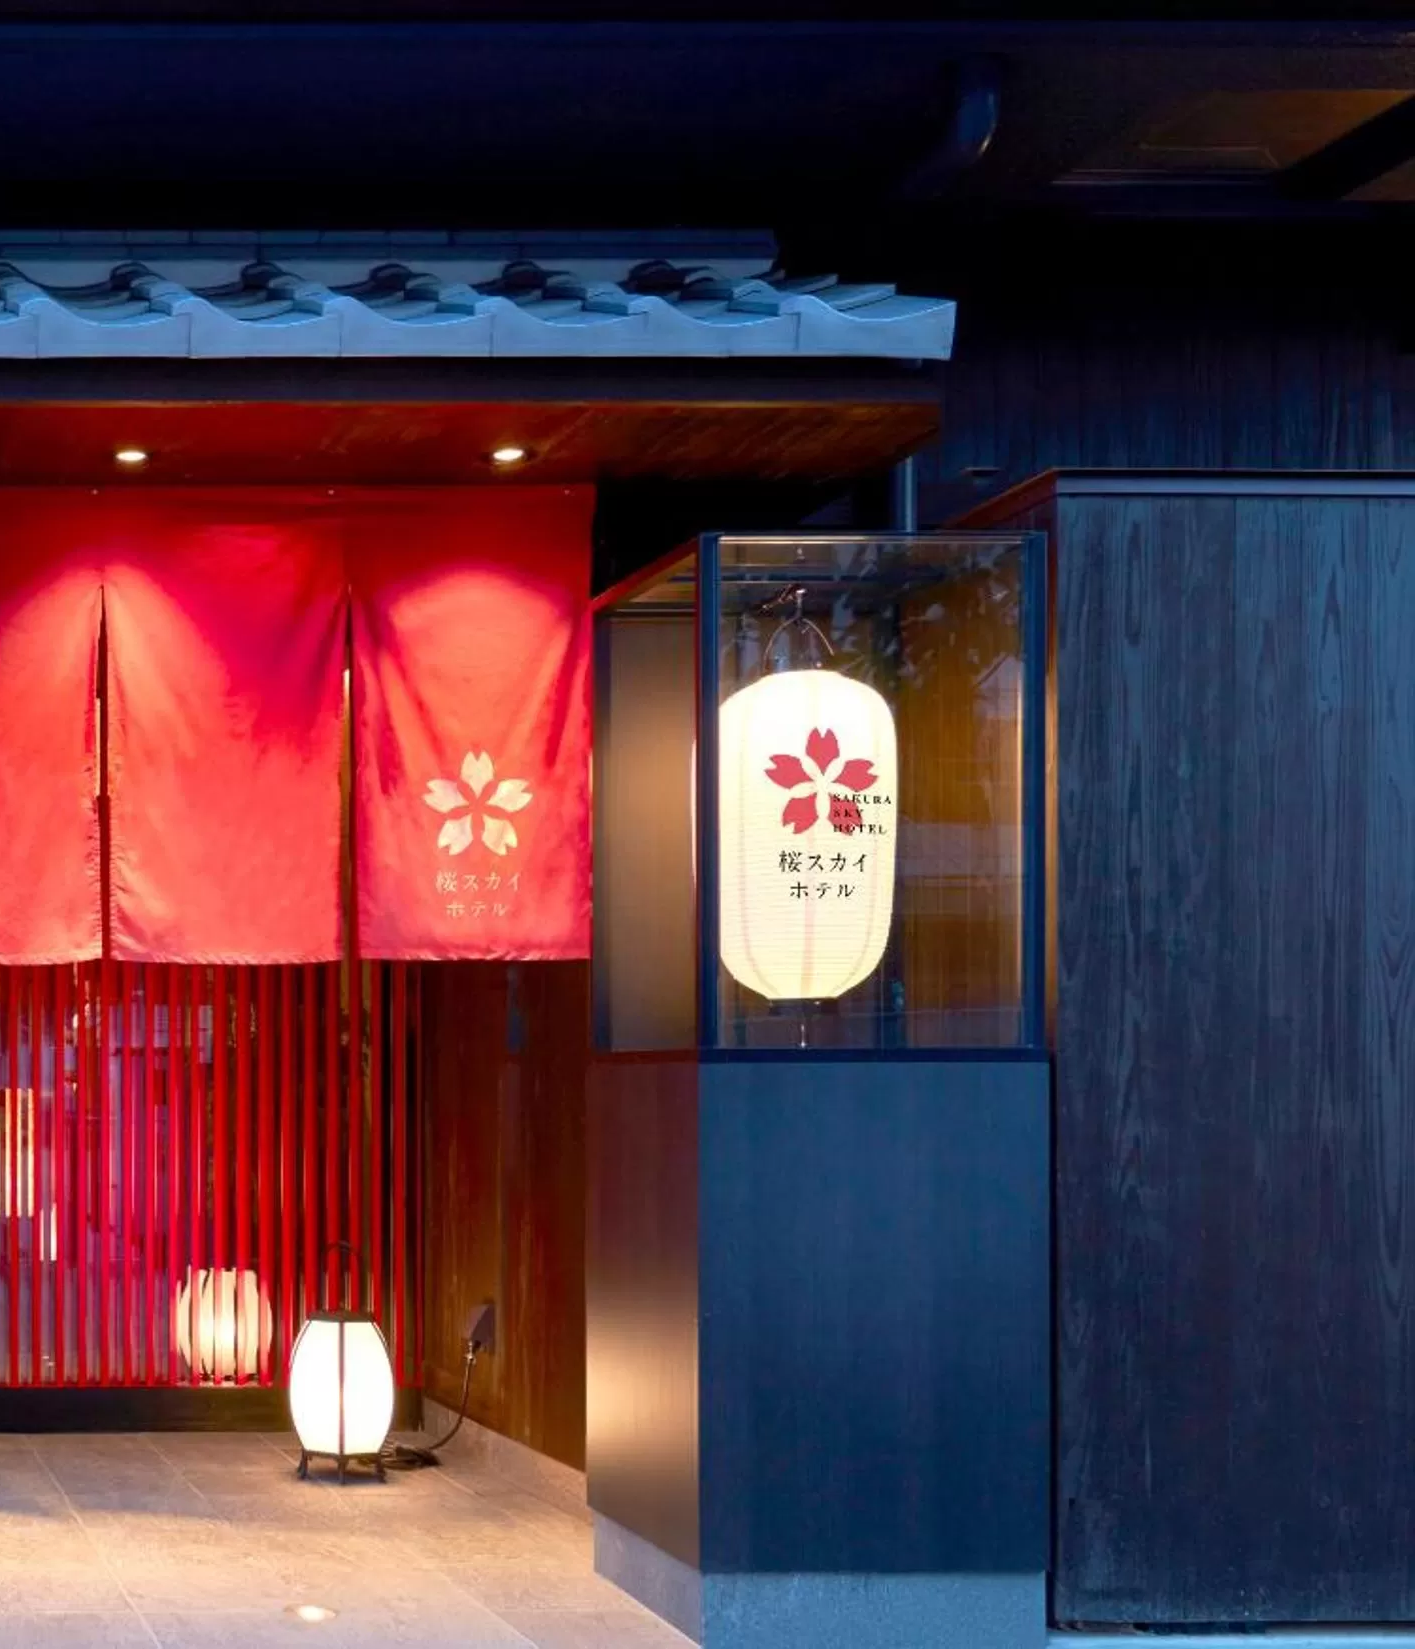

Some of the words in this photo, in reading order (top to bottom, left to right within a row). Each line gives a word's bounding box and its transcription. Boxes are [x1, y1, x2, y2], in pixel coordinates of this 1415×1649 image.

[832, 793, 892, 805] SAKURA
[832, 808, 864, 818] SKY
[832, 823, 888, 835] HOTEL
[778, 850, 868, 873] 桜スカイ
[435, 871, 520, 893] 桜スカイ
[789, 881, 856, 899] ホテル
[445, 901, 508, 918] ホテル
